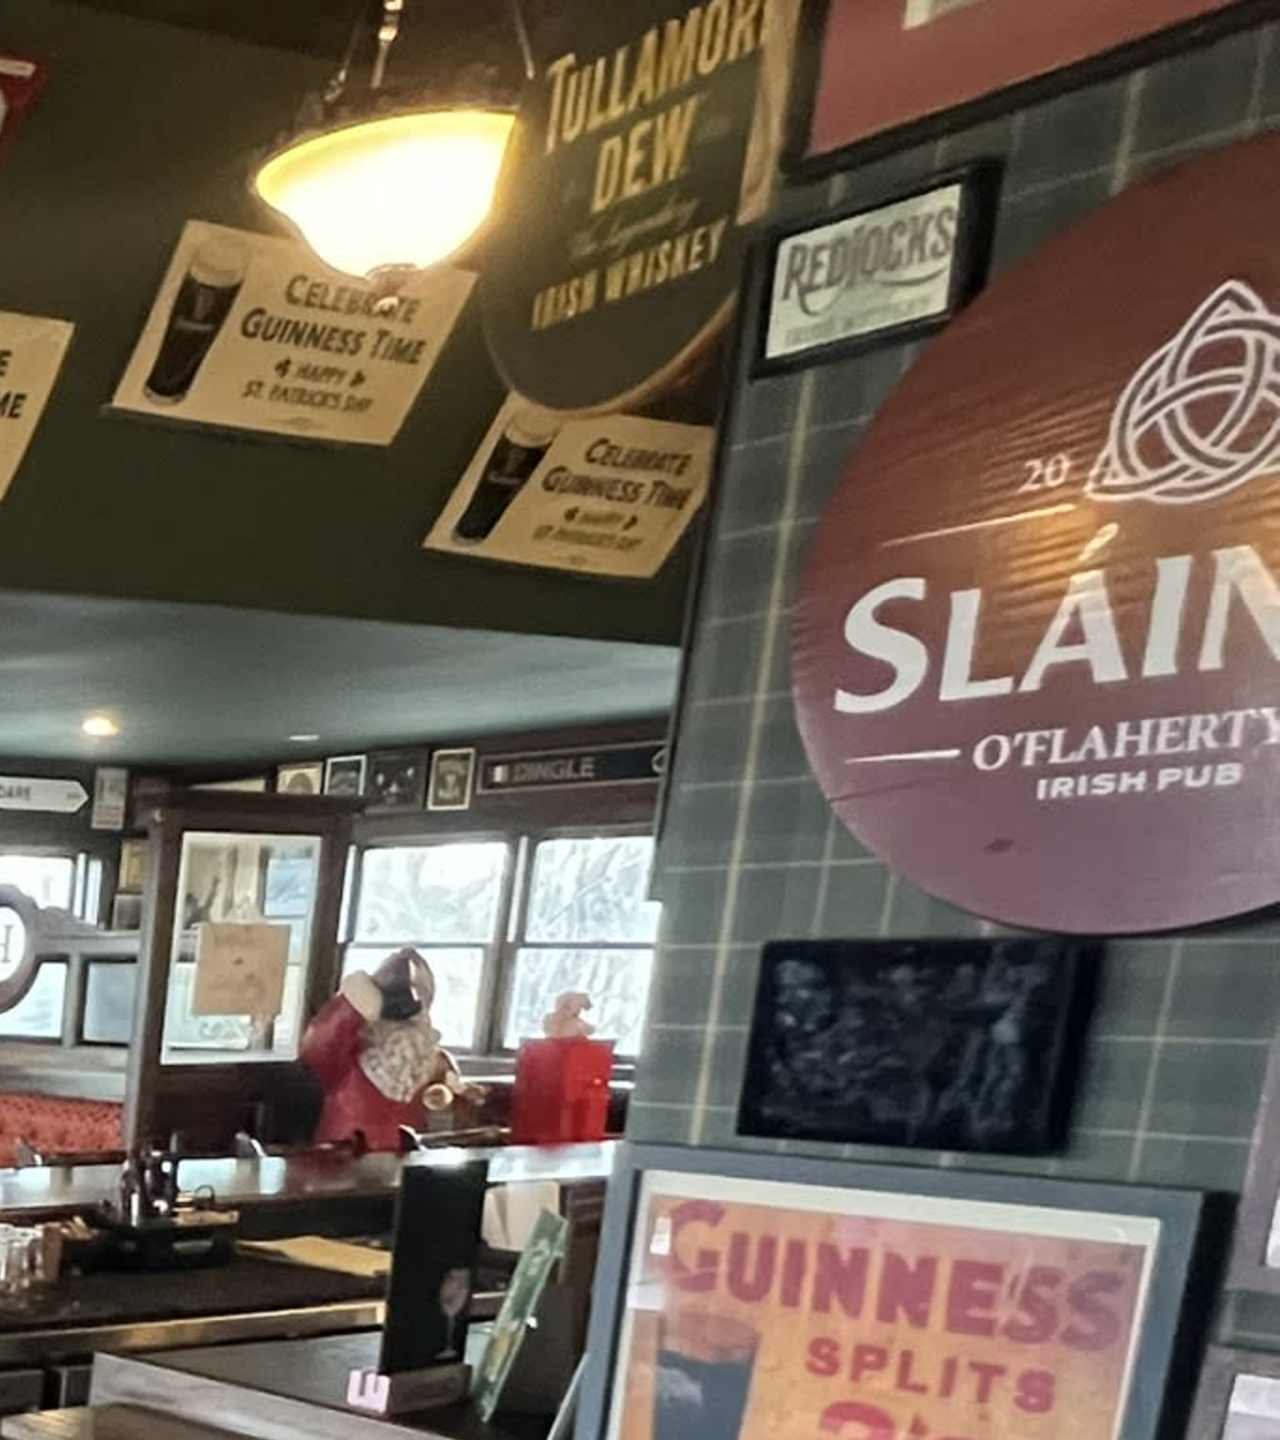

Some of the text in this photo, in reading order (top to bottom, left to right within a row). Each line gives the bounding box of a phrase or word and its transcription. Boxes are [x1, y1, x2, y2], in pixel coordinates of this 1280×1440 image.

[592, 96, 698, 213] DEW
[285, 273, 422, 324] CELEBRTE
[240, 306, 428, 365] GUINNESS TIME
[1018, 452, 1072, 493] 20
[1036, 761, 1245, 801] IRISH PUB
[671, 1201, 1122, 1350] GUINNESS
[805, 1336, 1057, 1416] SPLITS
